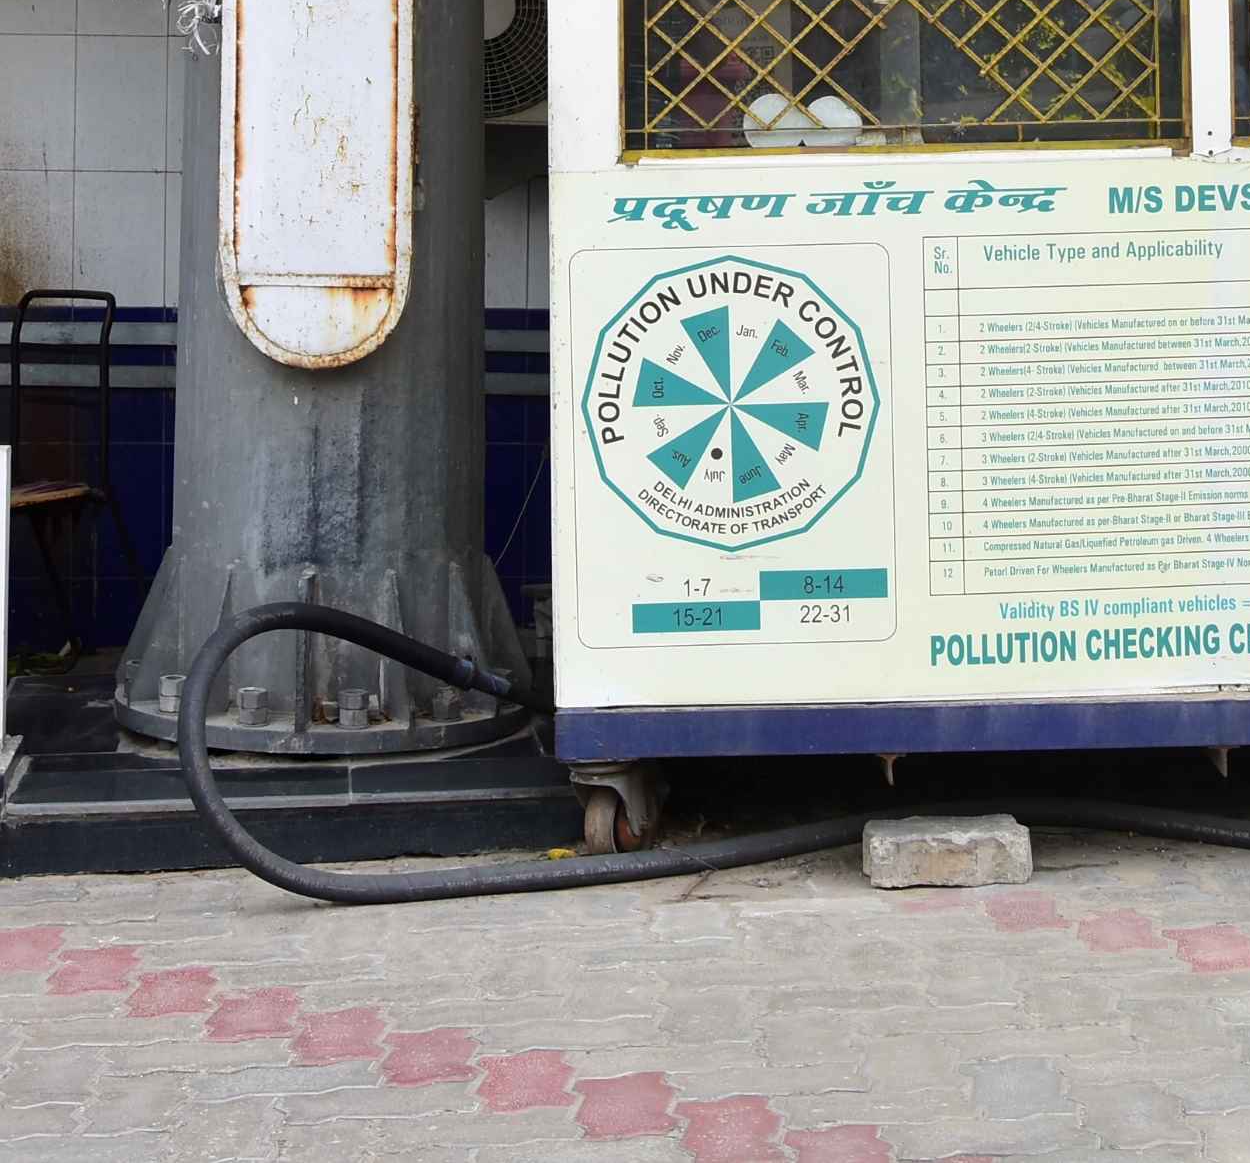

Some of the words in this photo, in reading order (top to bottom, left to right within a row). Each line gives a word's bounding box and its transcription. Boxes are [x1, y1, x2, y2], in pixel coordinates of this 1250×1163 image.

[607, 194, 796, 231] प्रदूषण
[806, 181, 934, 216] जाँच
[944, 180, 1068, 213] केन्द्र
[1109, 186, 1163, 213] M/S
[934, 246, 948, 259] Sr.
[984, 245, 1040, 261] Vehicle
[1046, 243, 1085, 263] Type
[1092, 242, 1119, 258] and
[1126, 239, 1223, 261] Applicability
[935, 261, 952, 274] No.
[736, 325, 758, 339] Jan.
[598, 286, 682, 445] POLLUTION
[687, 271, 795, 308] UNDER
[798, 300, 865, 438] CONTROL
[666, 344, 686, 365] Nov.
[792, 370, 810, 395] Mar.
[775, 443, 796, 466] May
[703, 468, 725, 483] July
[637, 488, 727, 535] DIRECTORATE
[730, 522, 749, 535] OF
[751, 484, 828, 533] TRANSPORT
[653, 479, 693, 517] DELHI
[694, 478, 811, 519] ADMINISTRATION
[684, 578, 711, 597] 1-7
[804, 575, 844, 594] 8-14
[673, 607, 722, 627] 15-21
[800, 605, 850, 623] 22-31
[1000, 600, 1055, 621] Validity
[1060, 600, 1079, 617] BS
[1085, 599, 1098, 616] IV
[1104, 597, 1173, 618] compliant
[1178, 594, 1236, 612] vehicles
[930, 630, 1076, 666] POLLUTION
[1086, 624, 1220, 661] CHECKING
